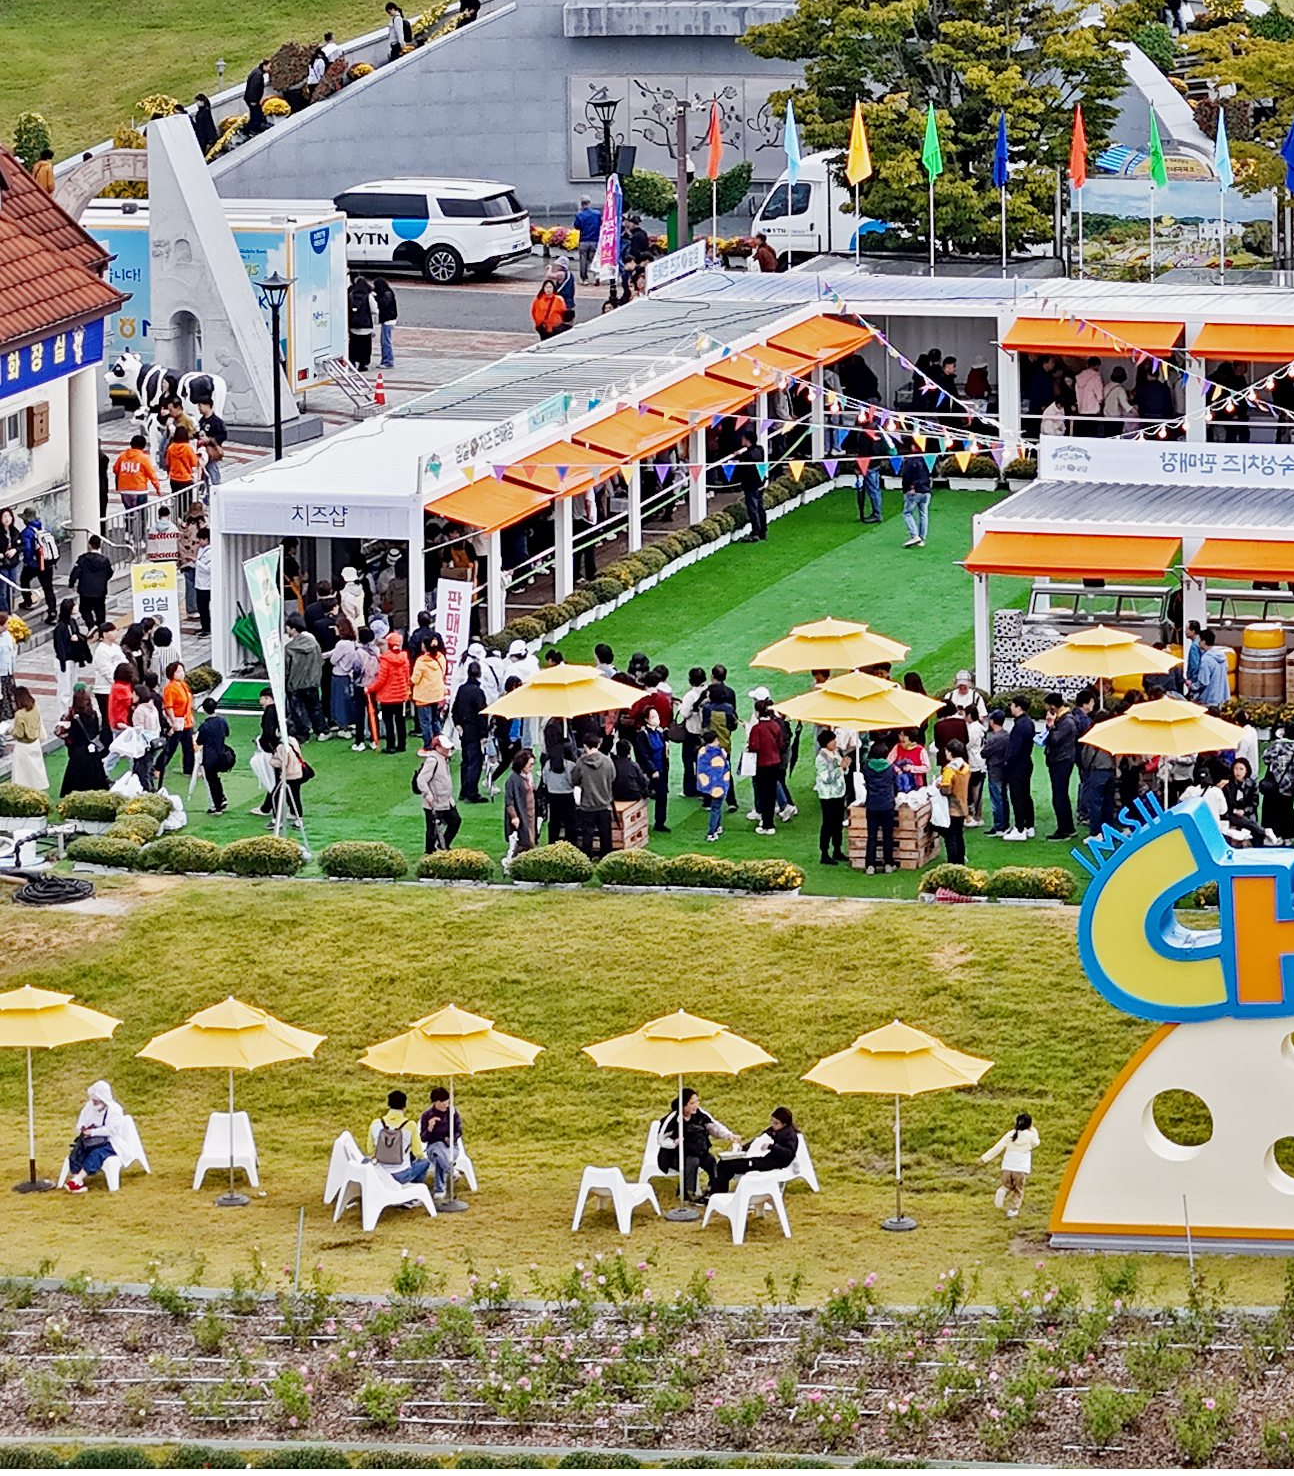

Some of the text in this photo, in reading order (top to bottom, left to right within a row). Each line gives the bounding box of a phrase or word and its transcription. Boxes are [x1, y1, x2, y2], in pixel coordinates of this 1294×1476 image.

[354, 232, 389, 246] YTN
[291, 504, 349, 528] 치즈샵
[142, 596, 169, 613] 임실
